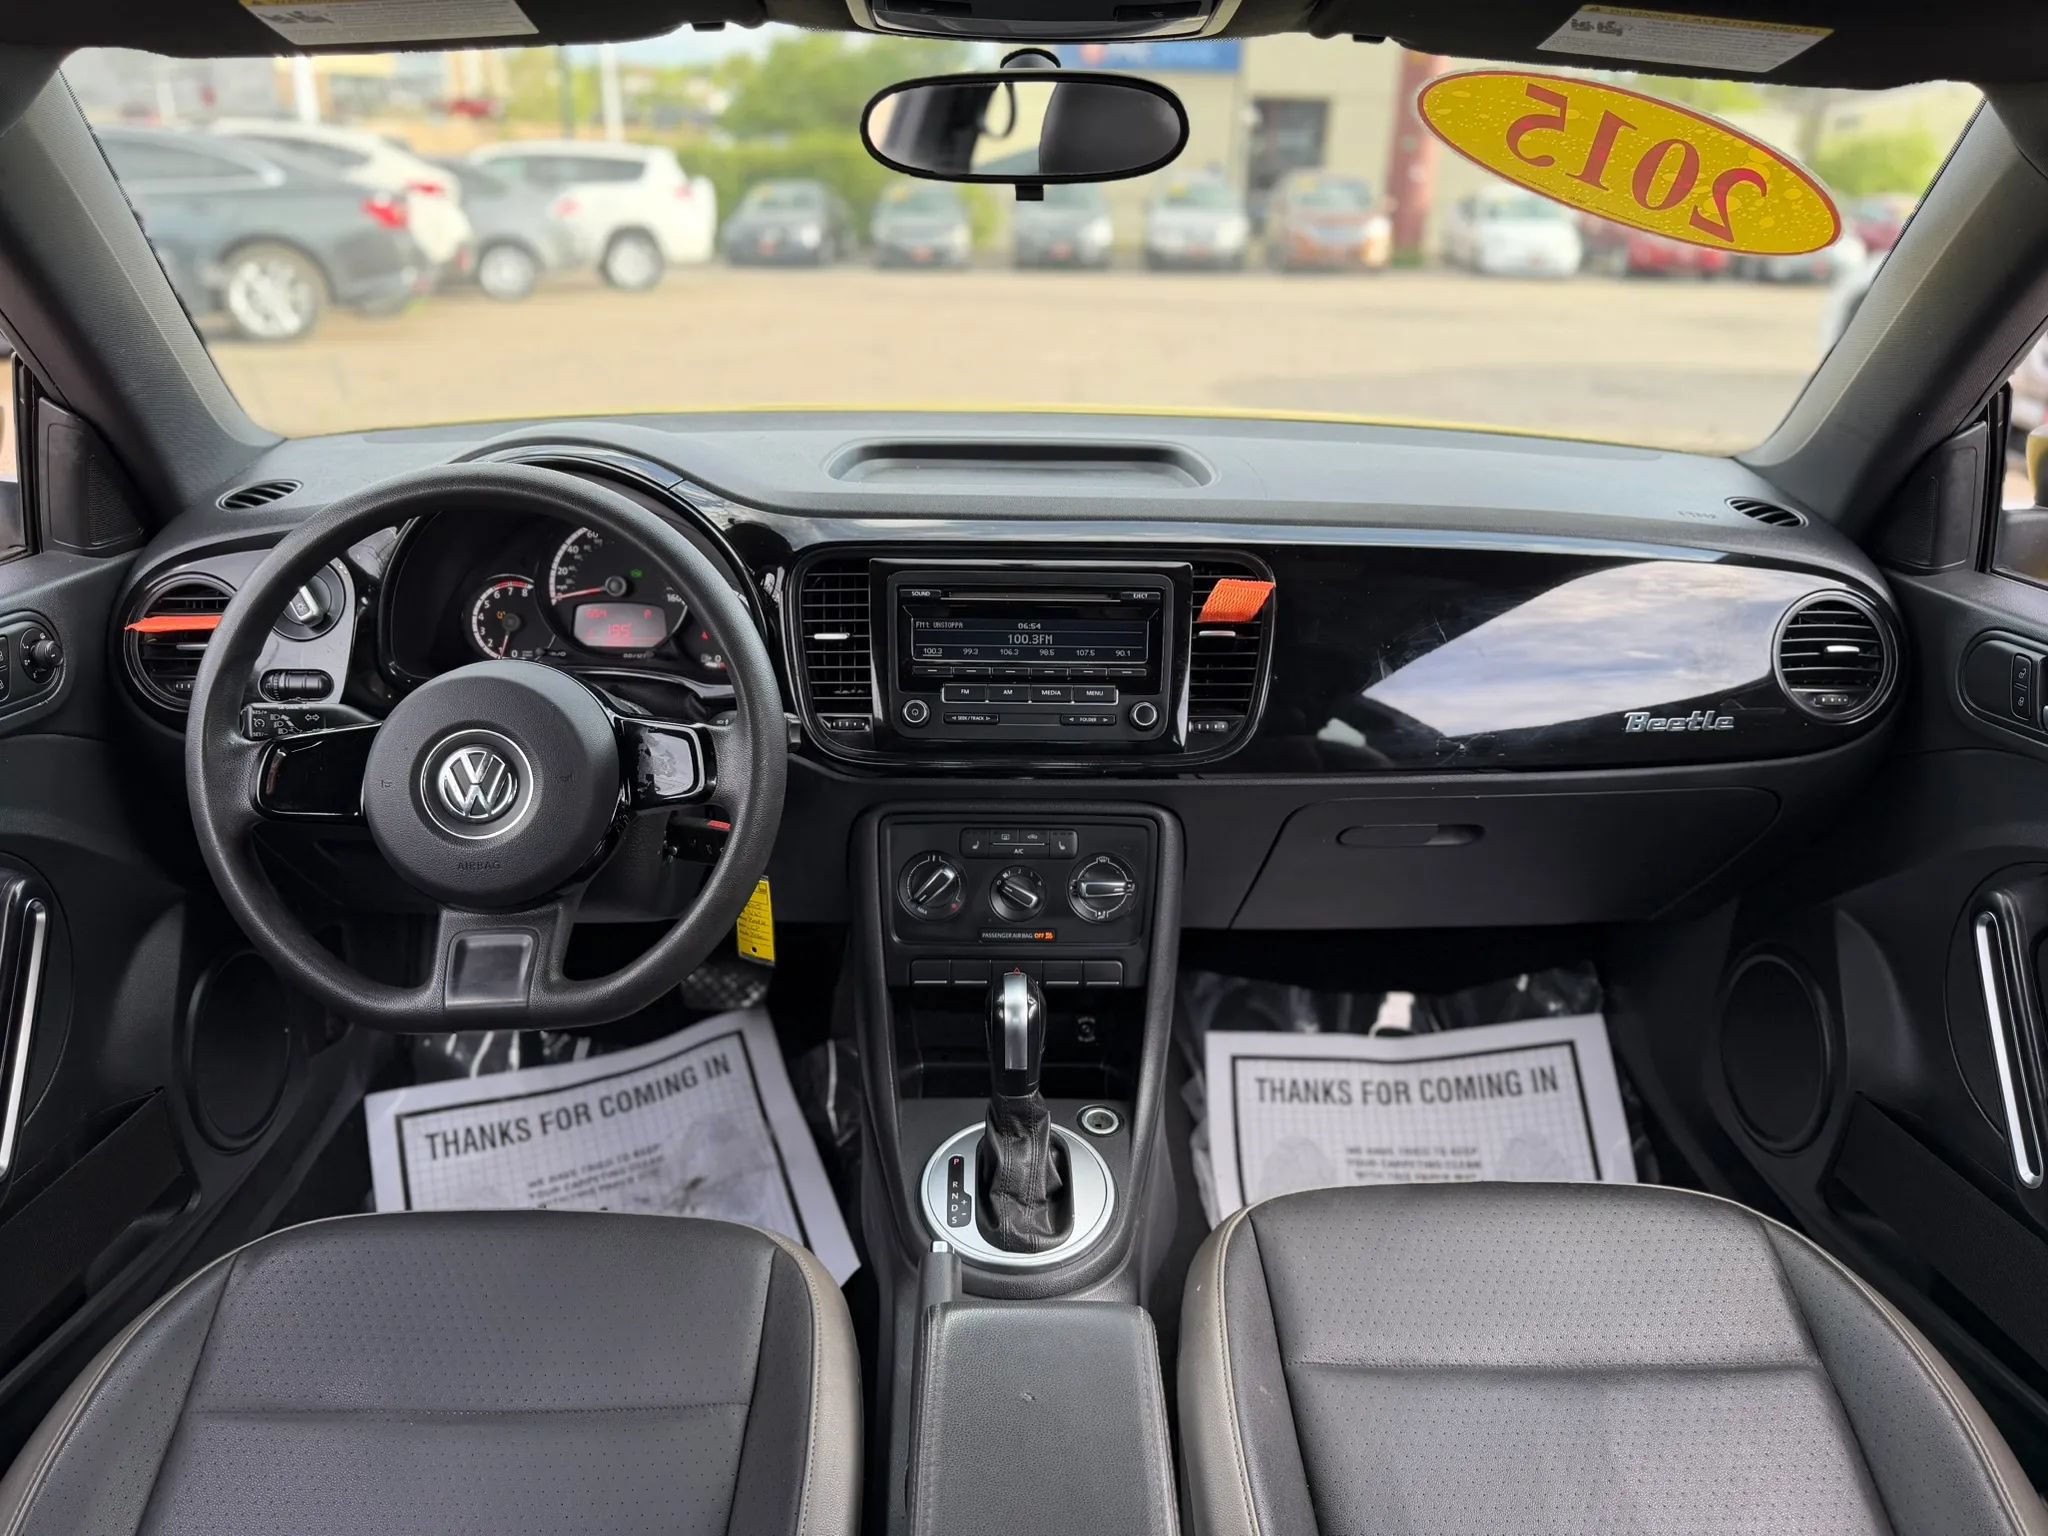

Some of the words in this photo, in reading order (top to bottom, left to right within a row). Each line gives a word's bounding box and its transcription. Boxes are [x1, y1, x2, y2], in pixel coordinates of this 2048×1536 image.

[567, 545, 579, 554] 40
[557, 566, 568, 575] 20
[1008, 634, 1053, 645] 100.3FM
[923, 647, 942, 655] 100.3
[1000, 648, 1019, 656] 106.3
[1115, 649, 1130, 657] 90.1
[1624, 710, 1734, 733] Beetle
[1255, 1077, 1352, 1108] THANKS
[1361, 1079, 1410, 1108] FOR
[1419, 1070, 1523, 1104] COMING
[1532, 1065, 1560, 1094] IN
[425, 1118, 532, 1161] THANKS
[539, 1103, 594, 1136] FOR
[600, 1067, 698, 1119] COMING
[703, 1053, 732, 1081] IN
[951, 1192, 959, 1200] N
[951, 1204, 958, 1212] D
[951, 1216, 957, 1224] S
